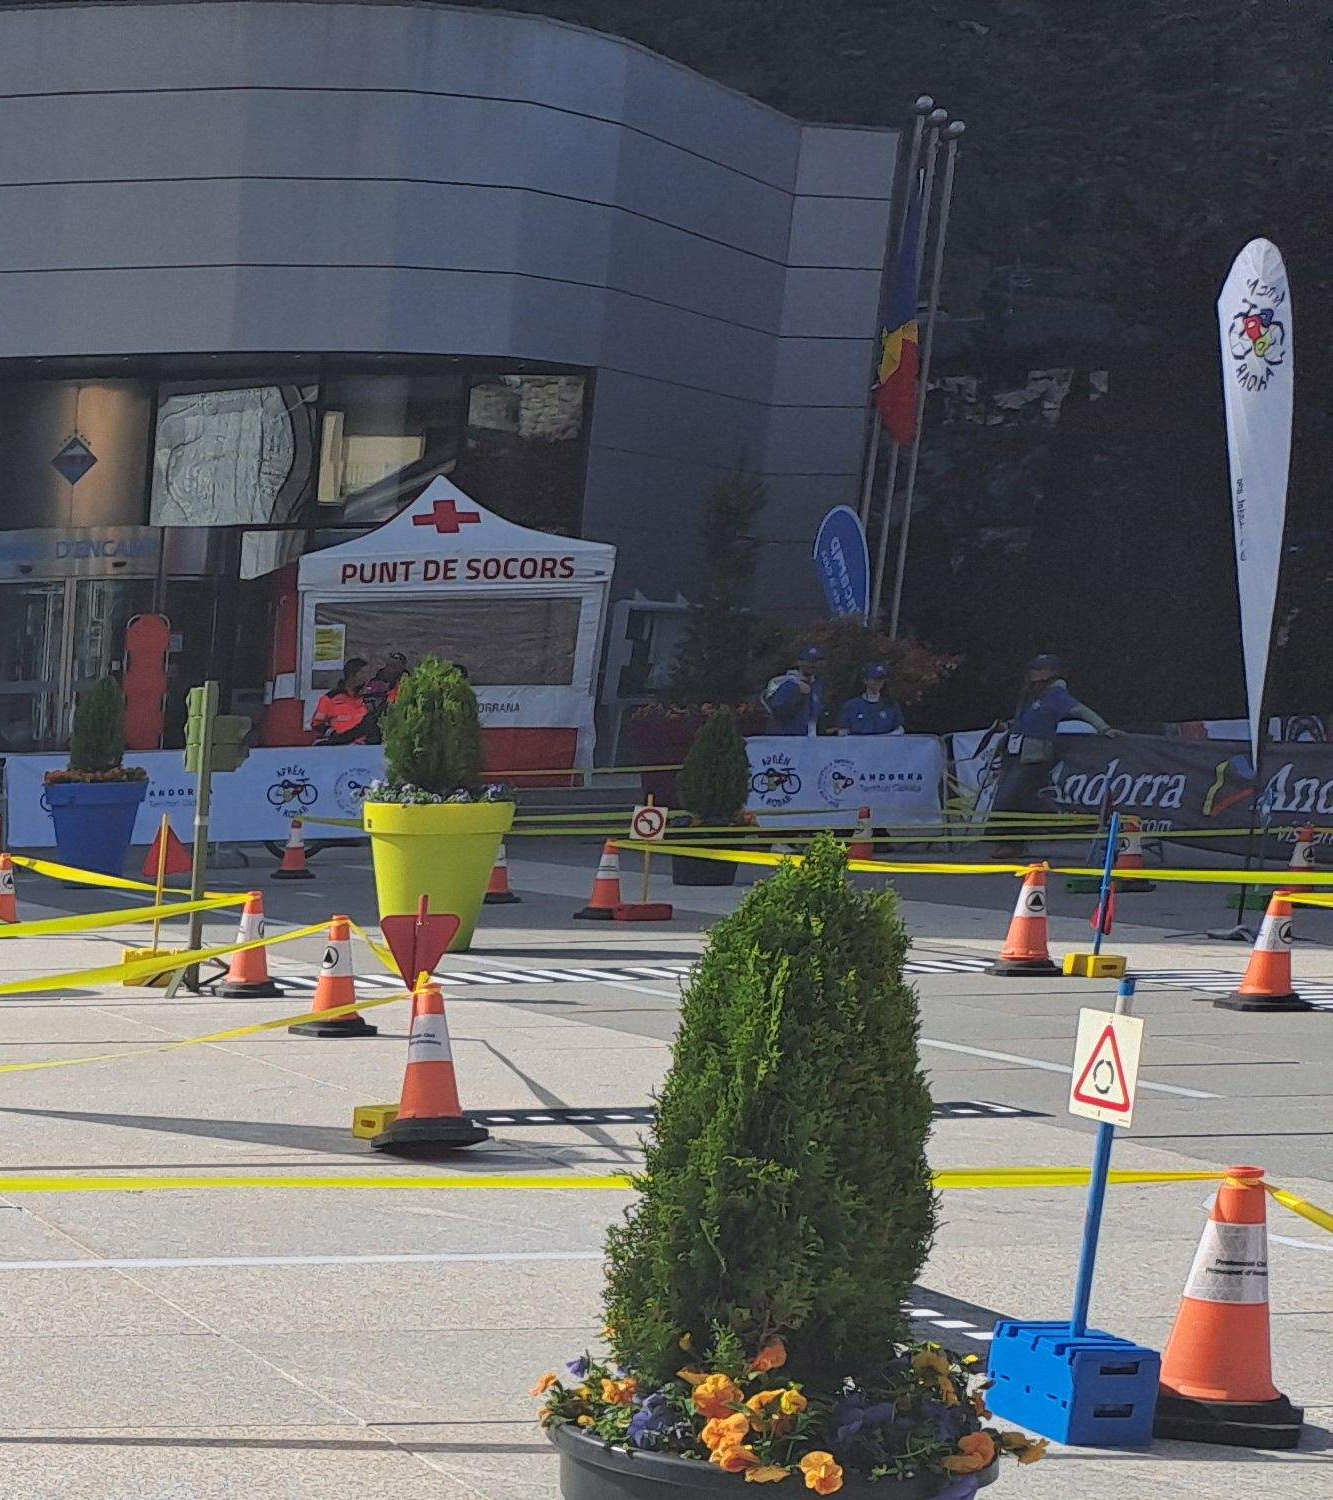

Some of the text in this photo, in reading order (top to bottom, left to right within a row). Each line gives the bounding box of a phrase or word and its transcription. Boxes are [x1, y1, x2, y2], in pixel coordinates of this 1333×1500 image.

[341, 556, 576, 585] PUNT DE SOCORS
[859, 773, 923, 782] ANDORRA
